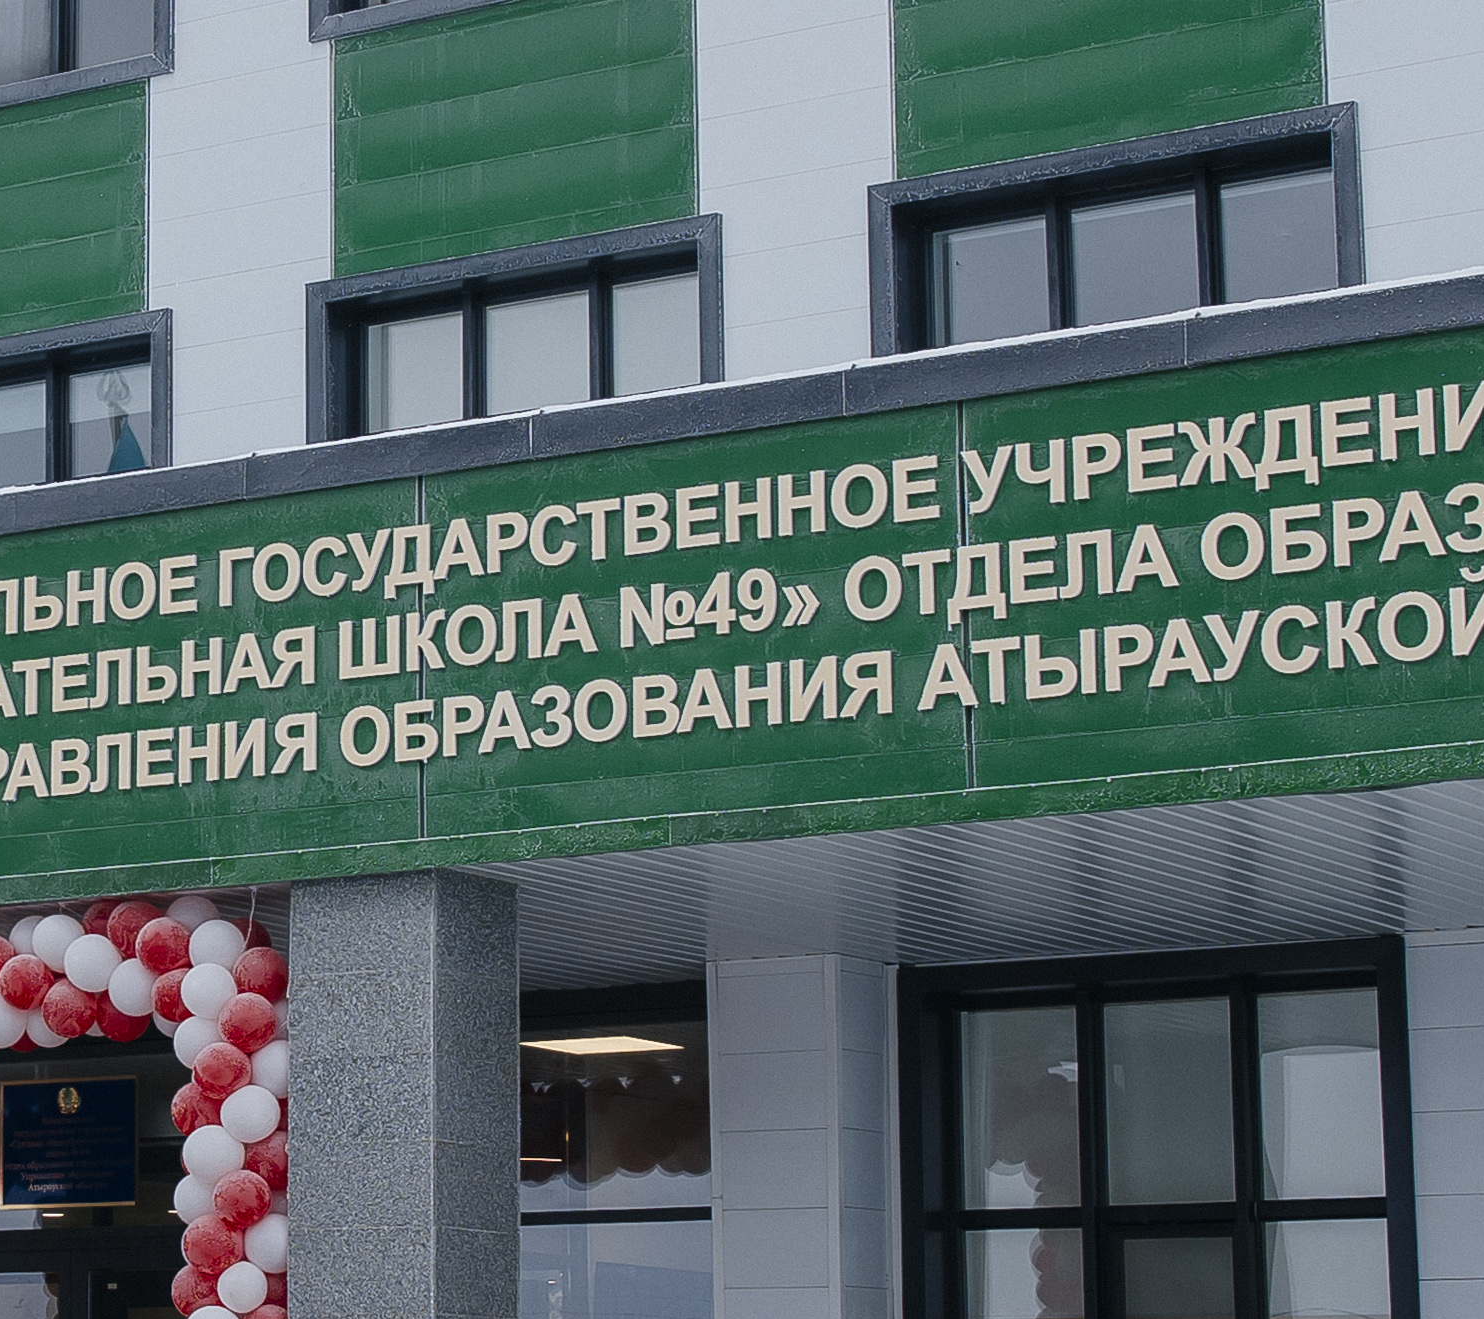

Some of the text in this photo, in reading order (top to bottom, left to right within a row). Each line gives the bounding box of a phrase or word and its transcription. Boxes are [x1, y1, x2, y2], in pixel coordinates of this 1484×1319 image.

[219, 455, 941, 607] ГОСУДАРСТВЕННОЕ
[338, 593, 599, 680] ШКОЛА
[620, 567, 821, 648] №49»
[845, 524, 1180, 625] ОТДЕЛА
[339, 650, 893, 767] ОБРАЗОВАНИЯ
